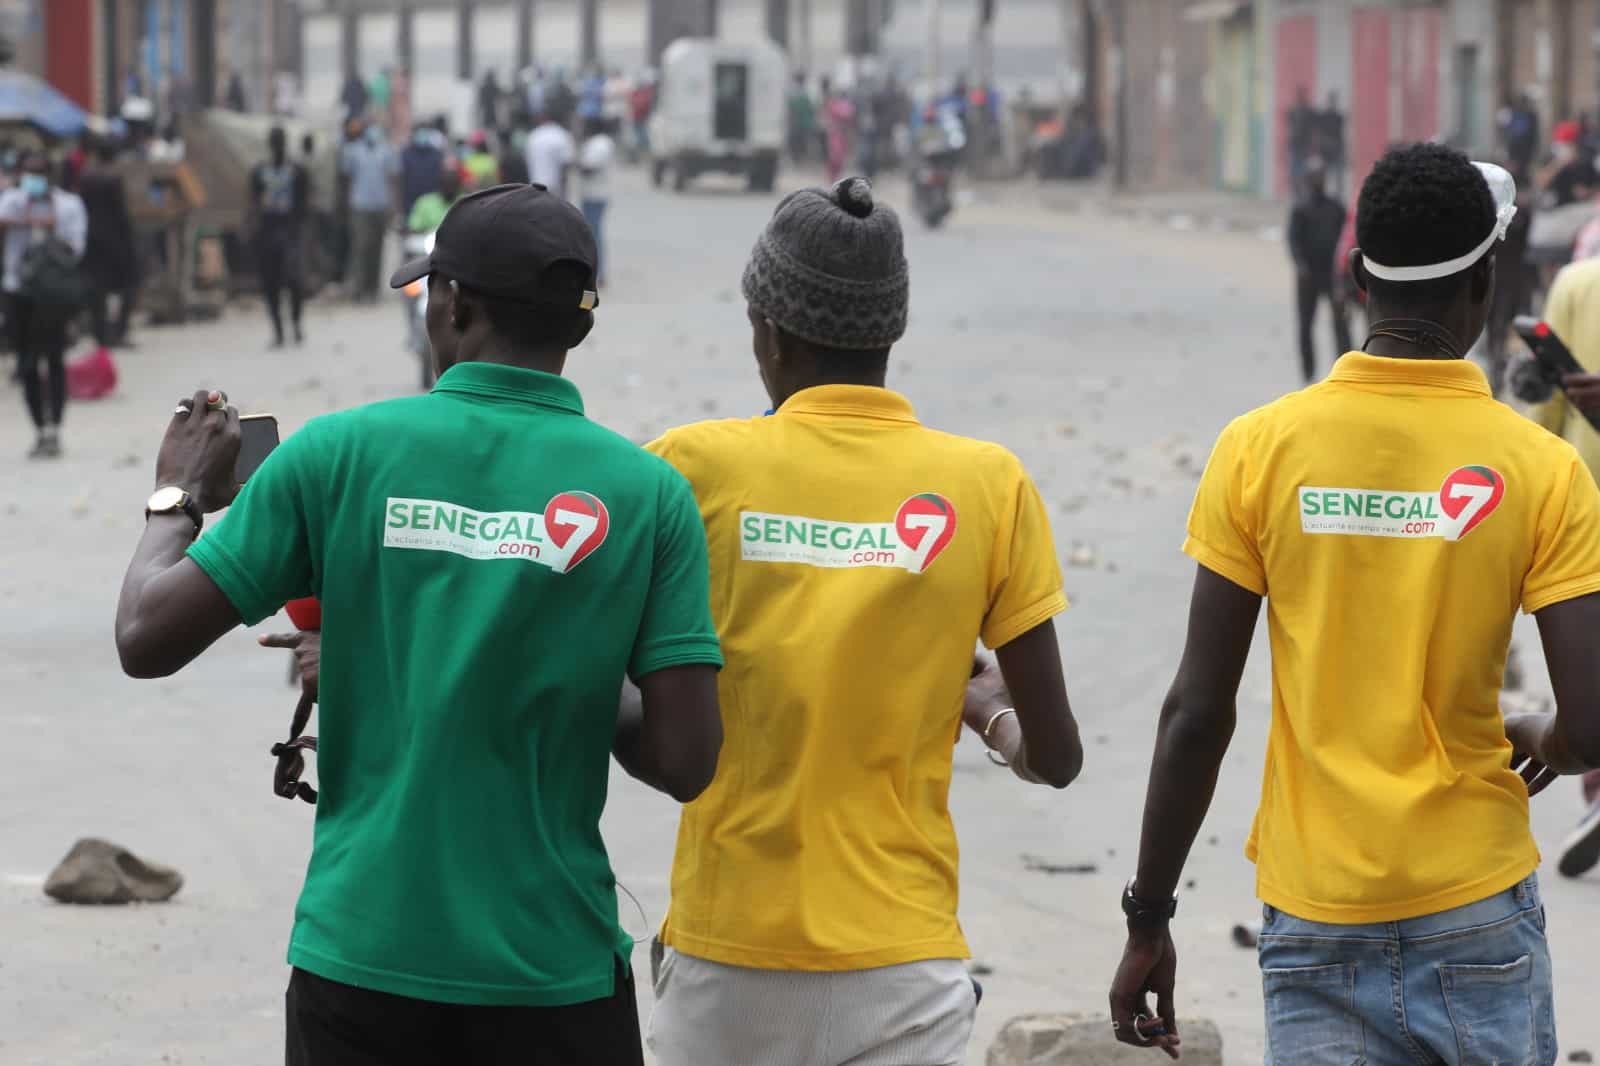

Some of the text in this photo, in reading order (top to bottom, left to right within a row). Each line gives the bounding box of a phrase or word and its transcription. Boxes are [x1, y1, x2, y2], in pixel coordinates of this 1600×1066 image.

[1302, 483, 1495, 541] SENEGAL 7
[1400, 522, 1436, 534] .com
[388, 503, 599, 574] SENEGAL 7
[494, 543, 540, 559] .com
[743, 513, 948, 573] SENEGAL 7
[848, 551, 896, 564] .com
